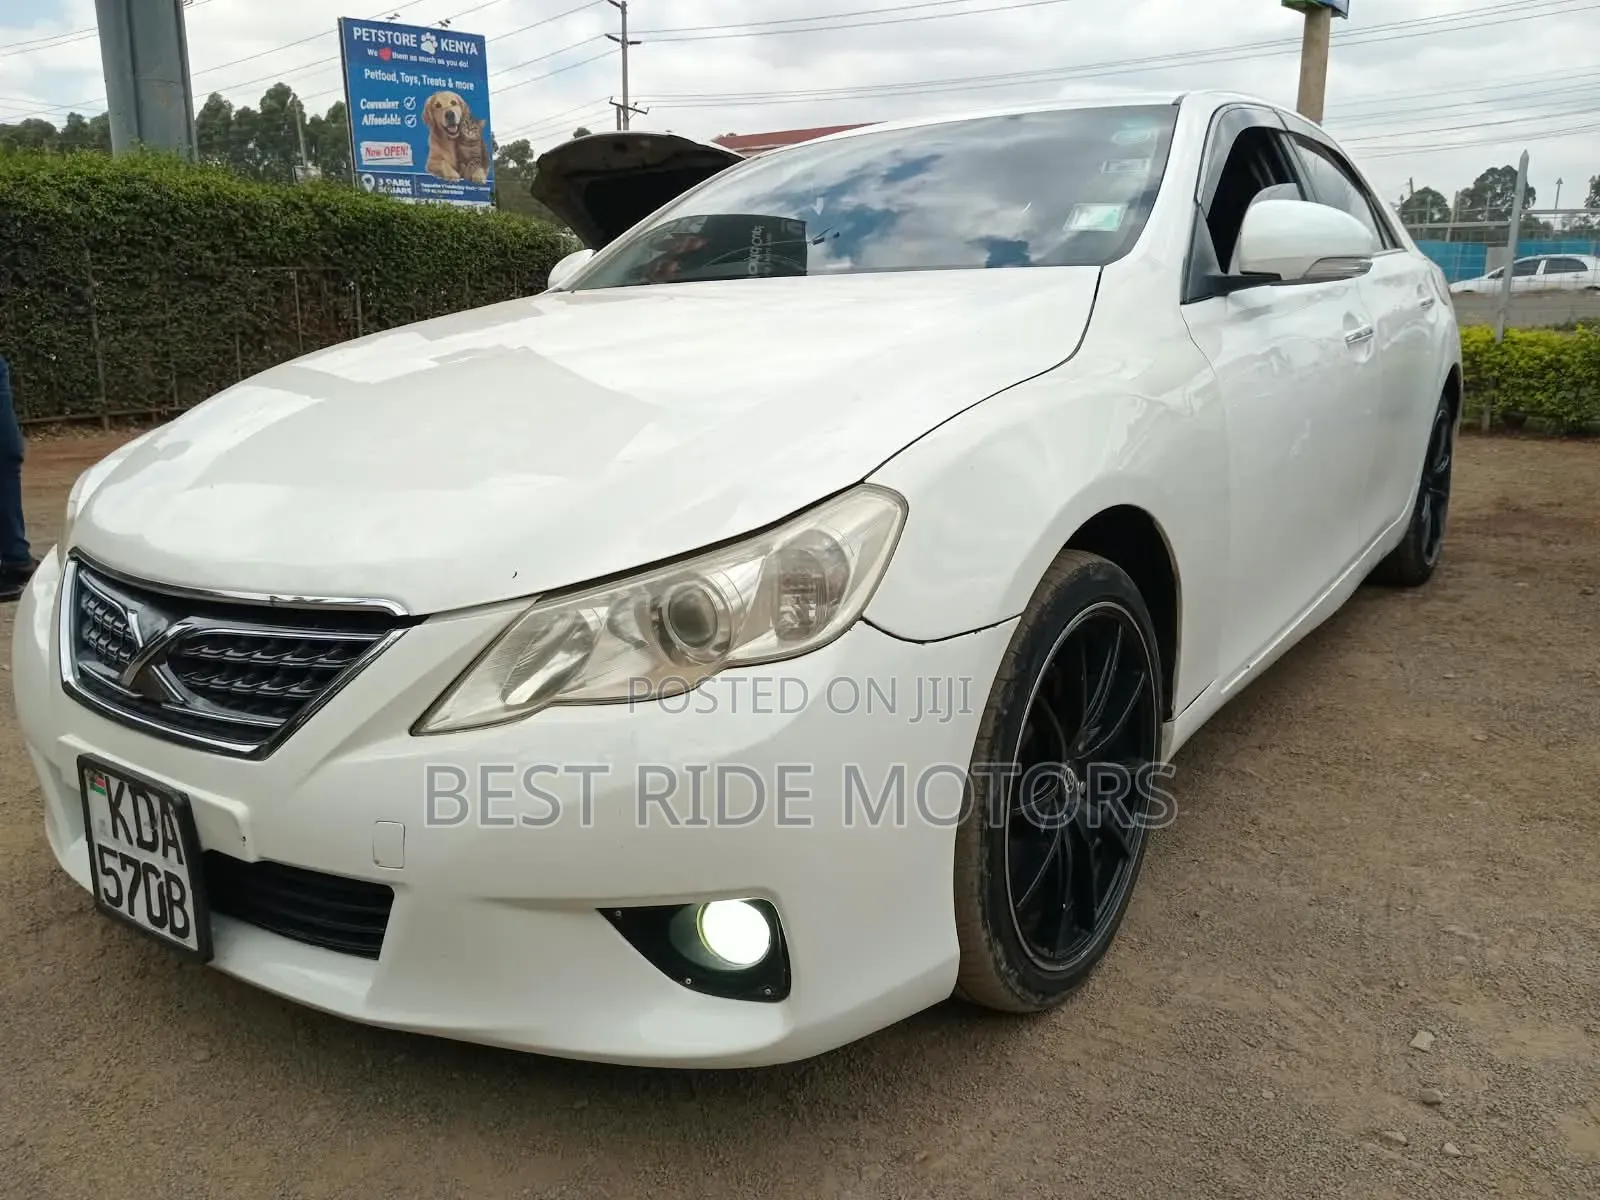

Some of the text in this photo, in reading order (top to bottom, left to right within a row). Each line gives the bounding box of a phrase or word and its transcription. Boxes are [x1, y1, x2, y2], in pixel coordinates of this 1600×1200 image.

[353, 27, 478, 55] PETSTORE KENYA
[367, 48, 378, 56] We
[392, 51, 408, 60] them
[419, 56, 436, 64] much
[446, 59, 458, 67] you
[459, 60, 469, 68] do!
[364, 68, 474, 91] Petfood, Toys, Treats & more
[365, 144, 409, 157] Now OPEN!
[105, 776, 184, 865] KDA
[98, 843, 190, 939] 570B
